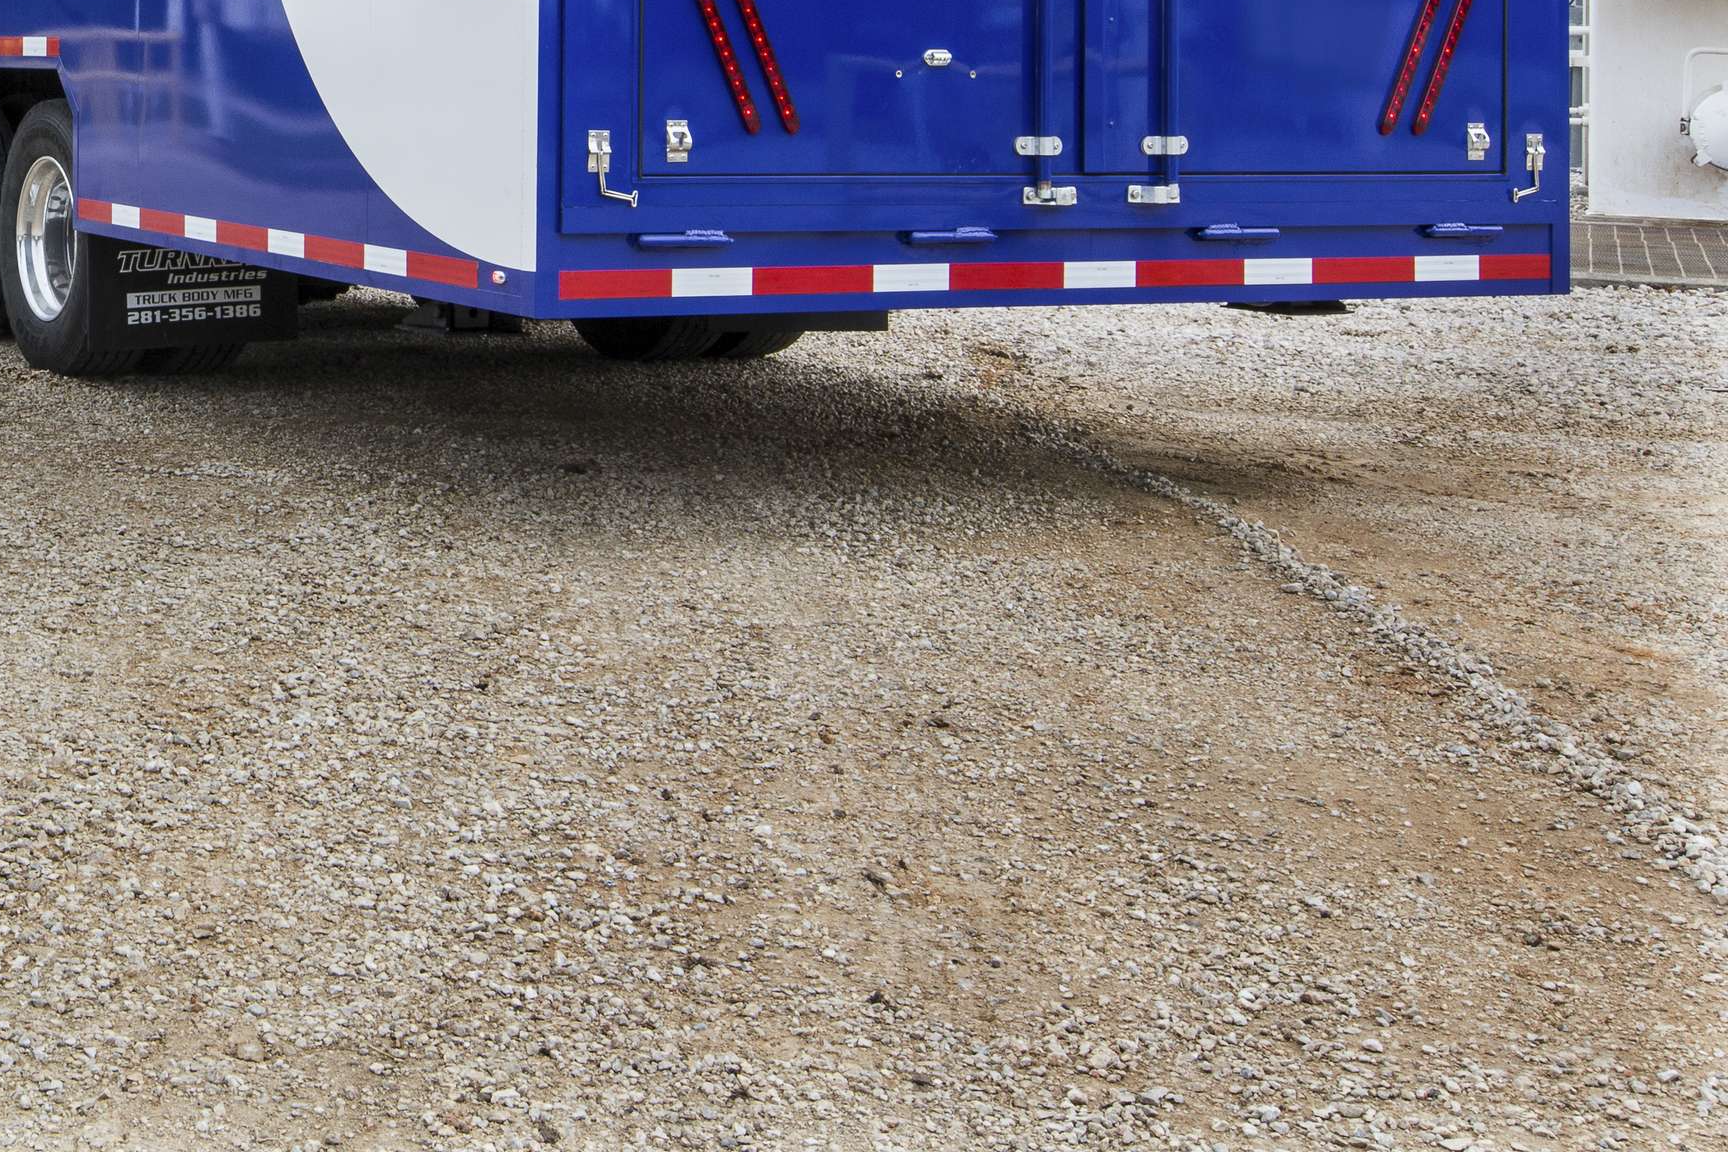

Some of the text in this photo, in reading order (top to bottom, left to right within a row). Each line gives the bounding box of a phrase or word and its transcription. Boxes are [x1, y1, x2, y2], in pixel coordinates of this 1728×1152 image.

[117, 248, 249, 272] TURN
[167, 269, 268, 285] Industries
[134, 288, 253, 306] TRUCK BODY MFG
[127, 304, 261, 325] 281-356-1386
